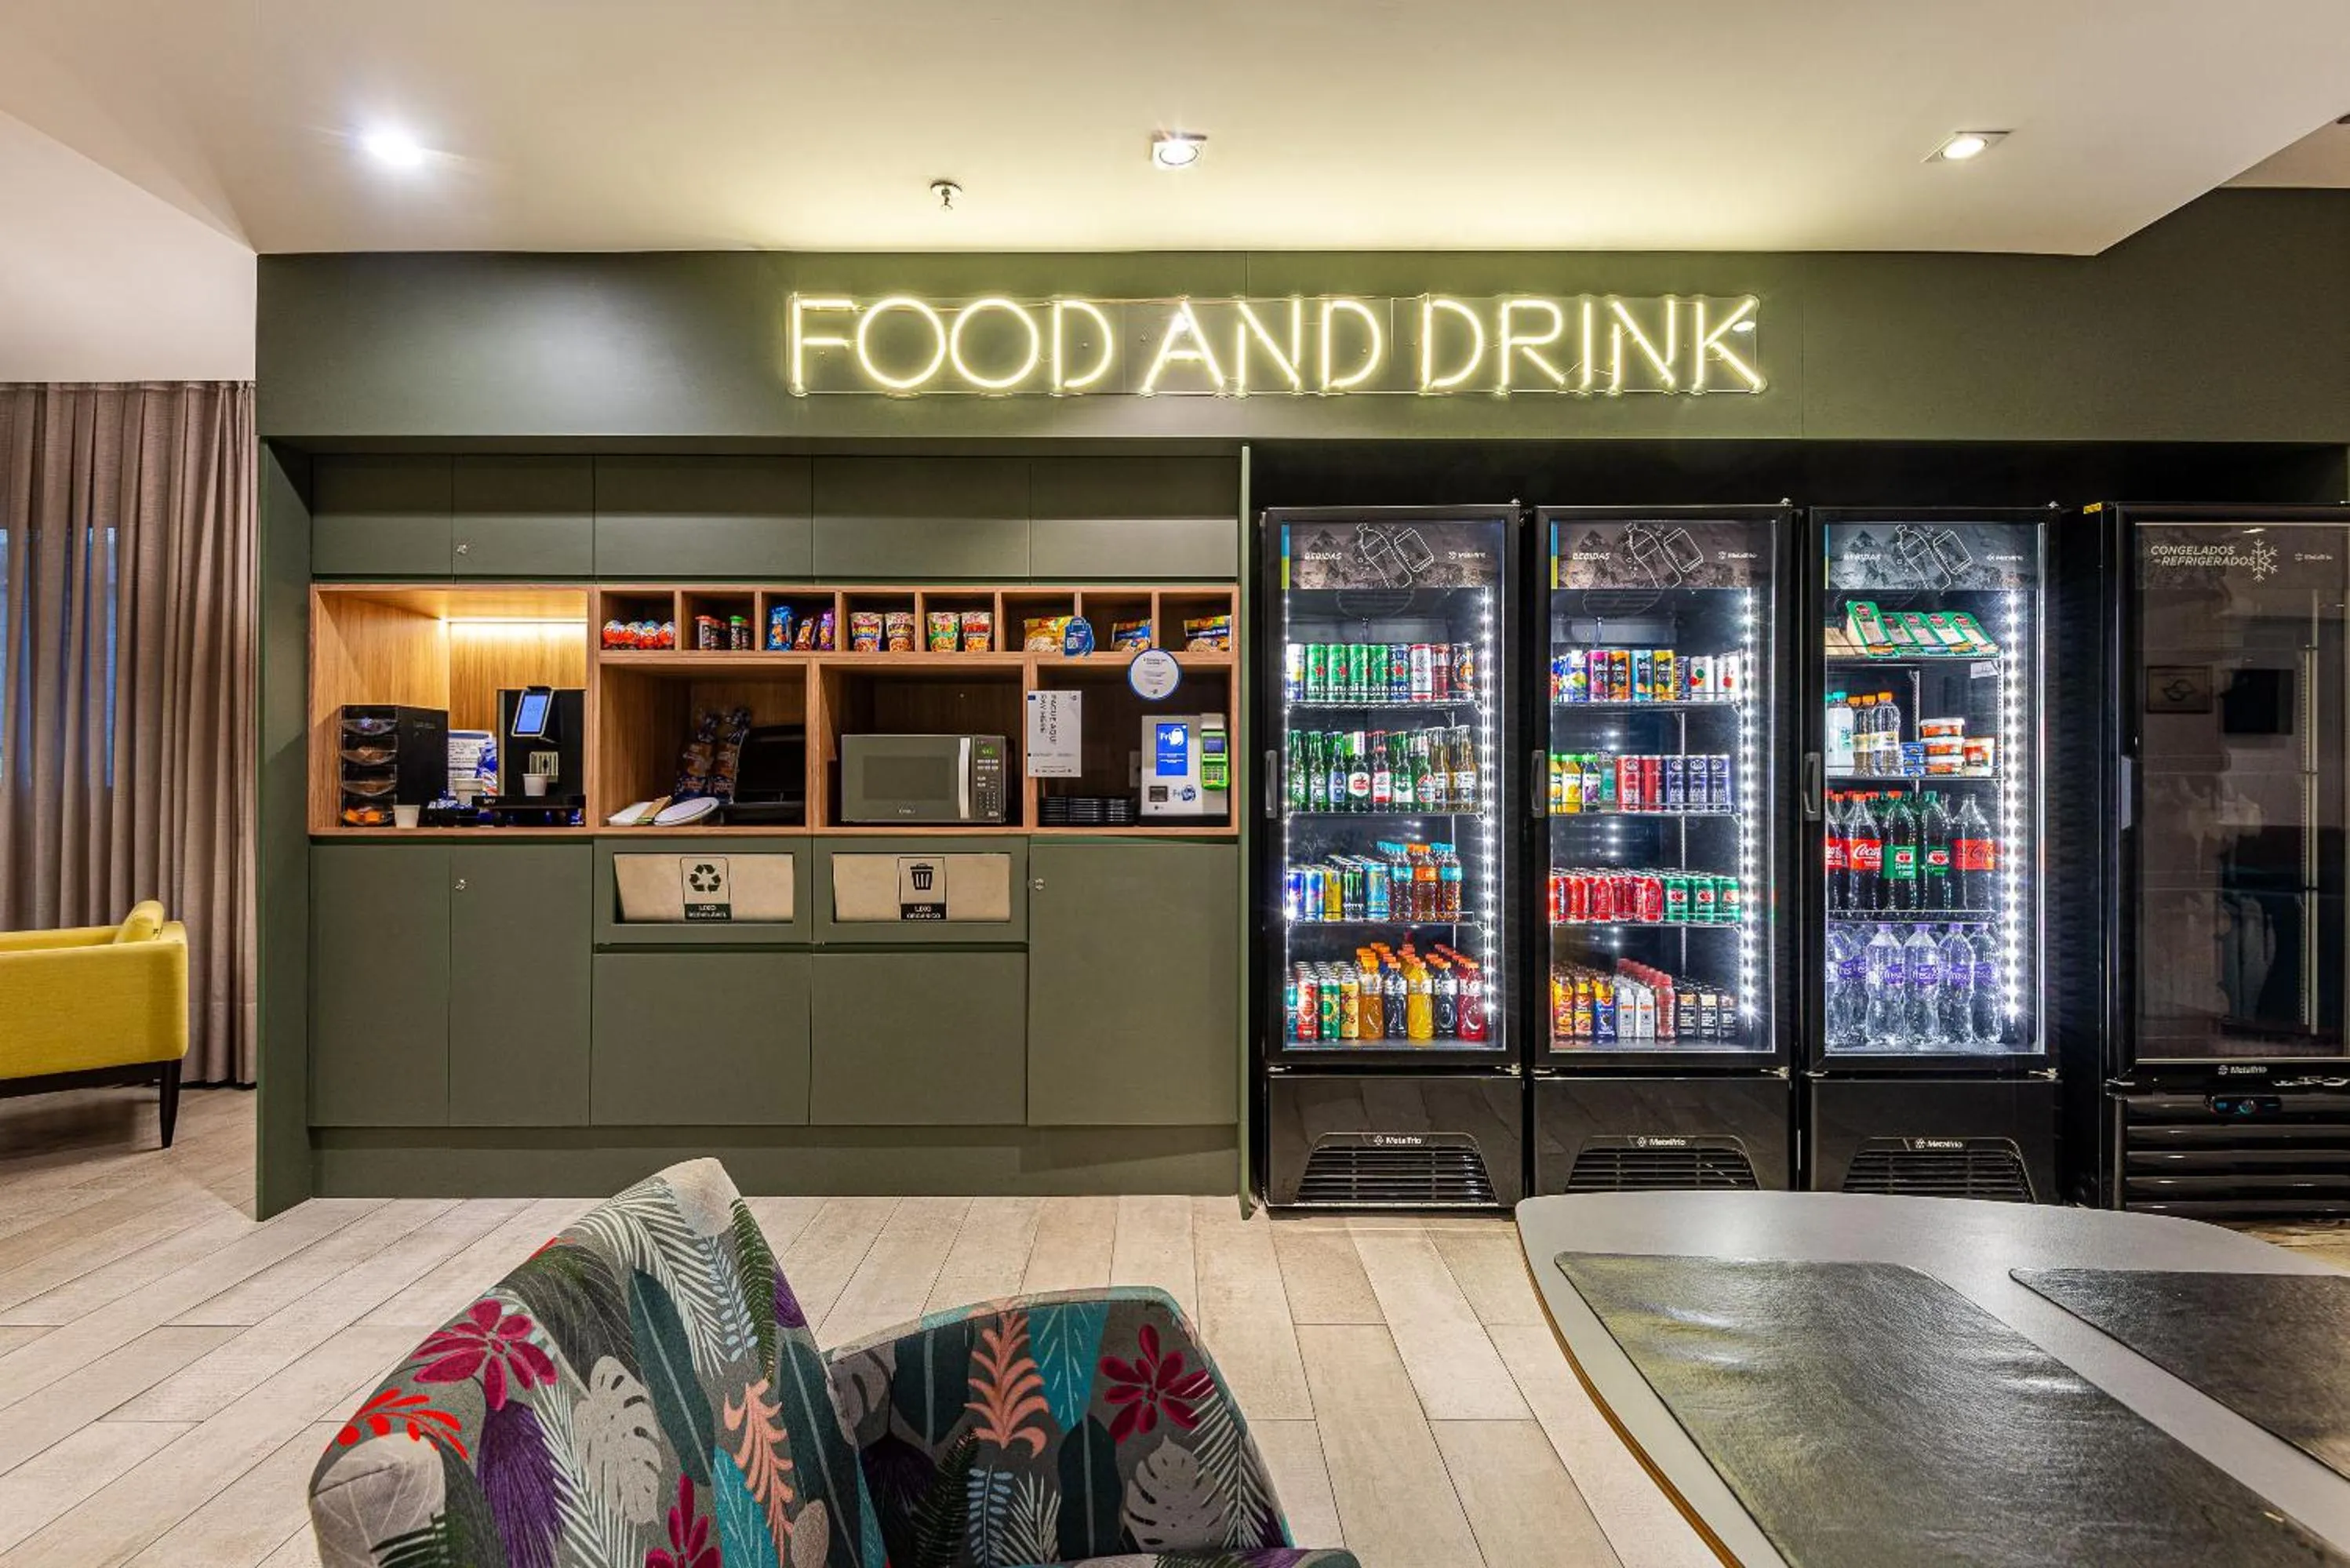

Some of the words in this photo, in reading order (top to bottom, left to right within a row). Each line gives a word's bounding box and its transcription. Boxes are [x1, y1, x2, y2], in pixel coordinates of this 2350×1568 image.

[791, 294, 1114, 395] FOOD
[1142, 294, 1384, 395] AND
[1421, 293, 1765, 395] DRINK
[2150, 545, 2235, 555] CONGELADOS
[2161, 555, 2255, 566] REFRIGERADOS
